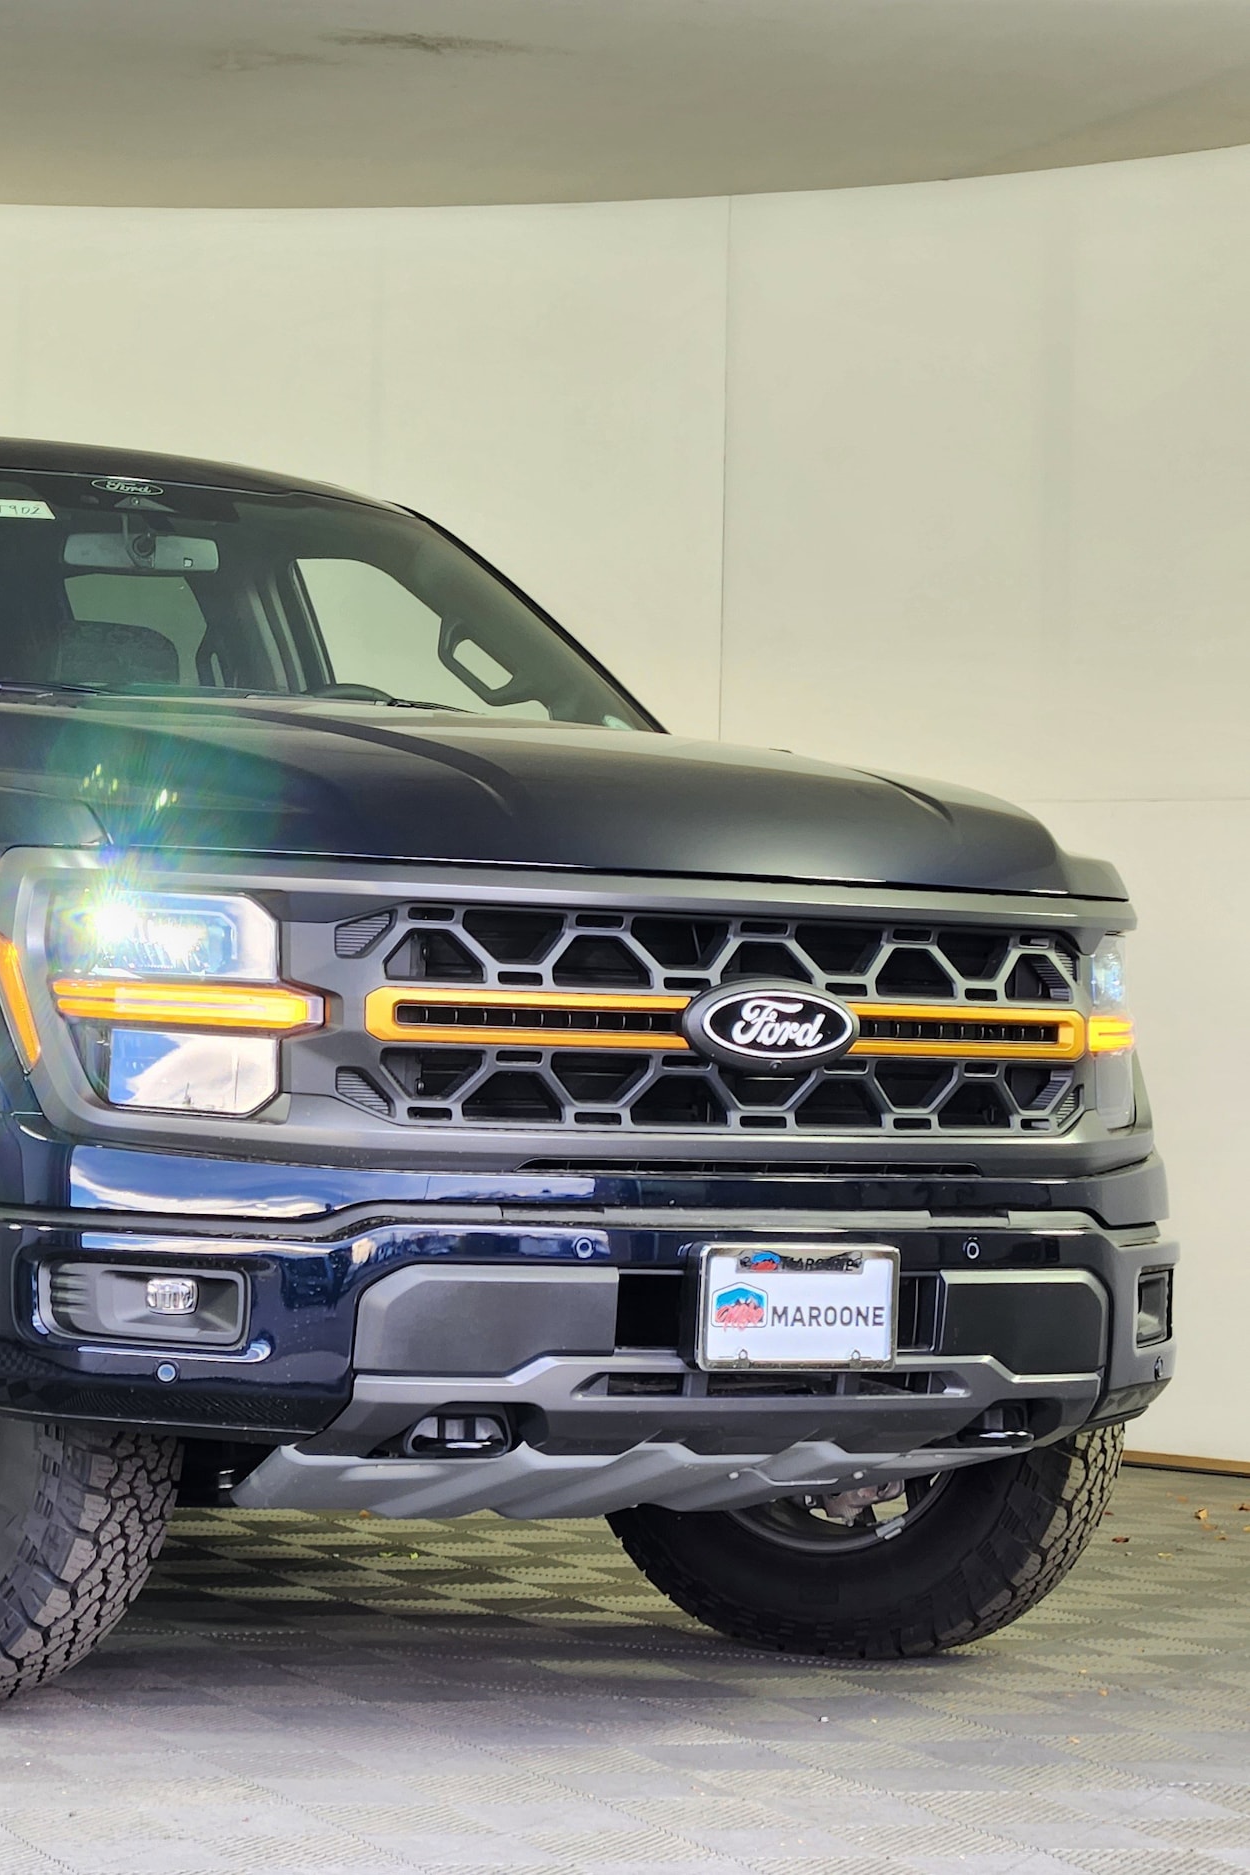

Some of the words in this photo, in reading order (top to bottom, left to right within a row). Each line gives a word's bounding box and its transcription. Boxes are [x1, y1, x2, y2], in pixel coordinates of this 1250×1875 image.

[106, 480, 152, 493] Ford
[731, 998, 825, 1048] Ford
[770, 1305, 886, 1328] MAROONE
